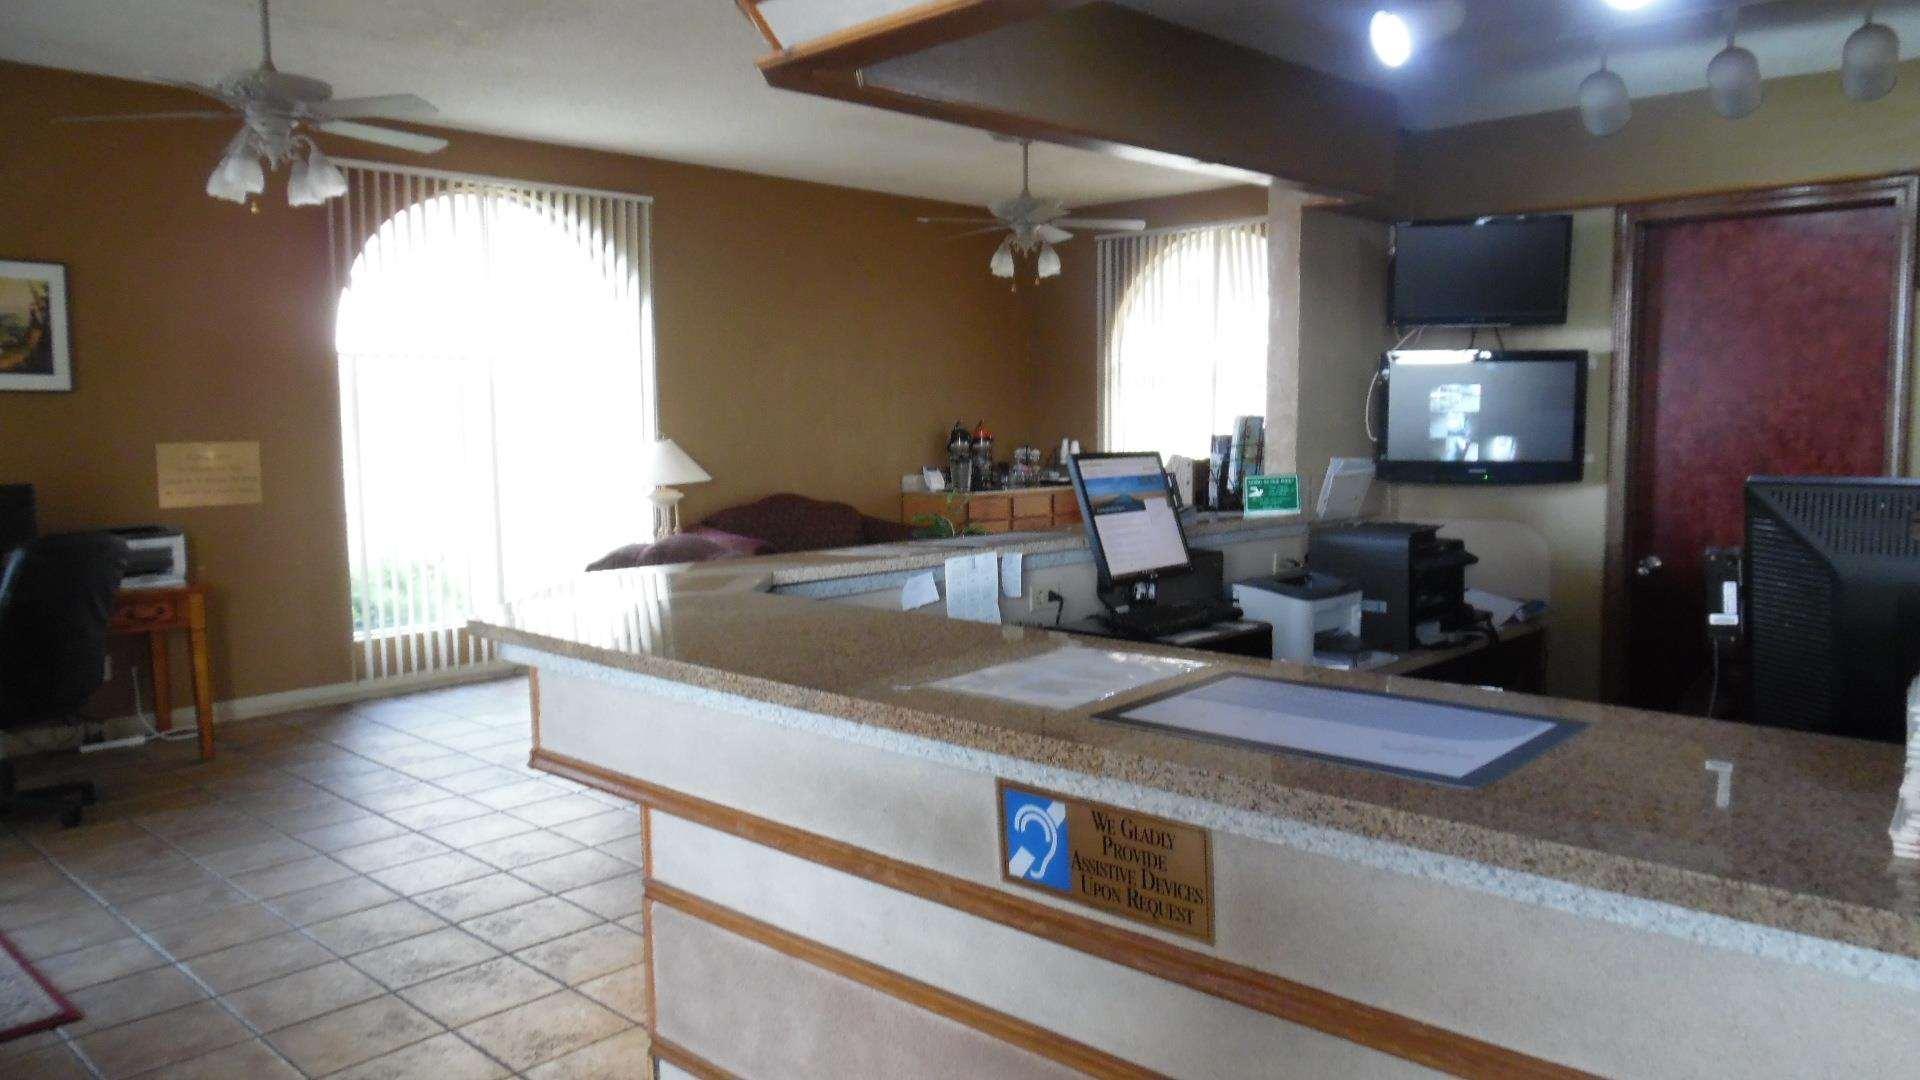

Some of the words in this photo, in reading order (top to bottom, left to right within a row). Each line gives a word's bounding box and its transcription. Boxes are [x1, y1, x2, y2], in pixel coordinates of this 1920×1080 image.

[1092, 811, 1115, 835] WE
[1120, 817, 1176, 850] GLADLY
[1102, 836, 1167, 870] PROVIDE
[1072, 850, 1136, 885] ASSISTIVE
[1142, 868, 1204, 904] DEVICES
[1081, 875, 1120, 902] UPON
[1127, 889, 1195, 924] REQUEST
